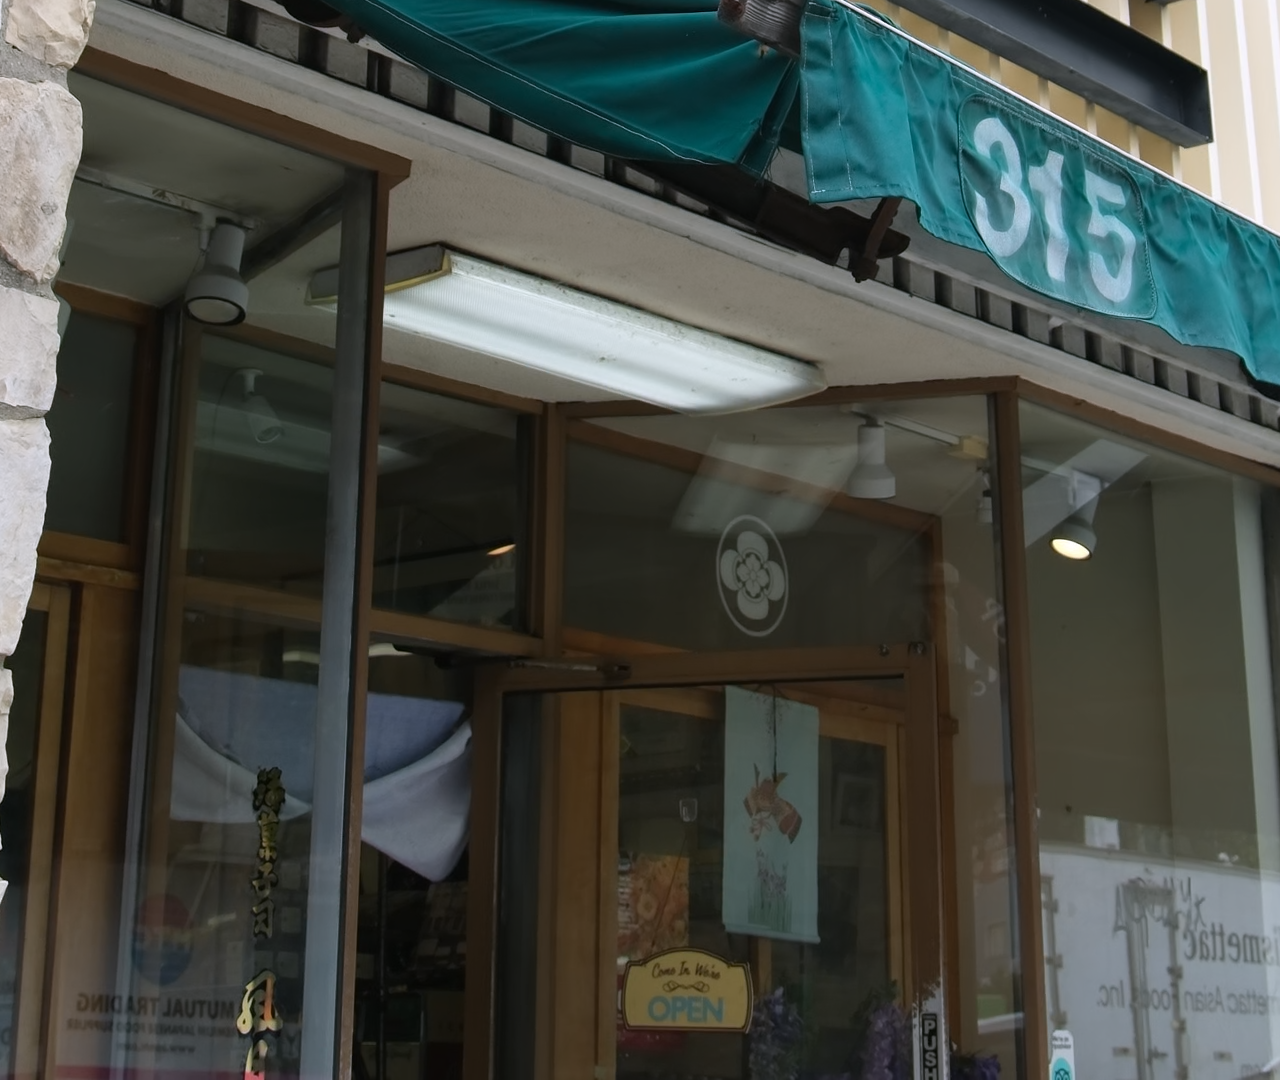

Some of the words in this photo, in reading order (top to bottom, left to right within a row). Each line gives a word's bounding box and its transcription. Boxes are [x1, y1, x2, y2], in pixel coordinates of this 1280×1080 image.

[973, 115, 1136, 304] 315
[677, 960, 691, 977] In
[647, 994, 725, 1024] OPEN
[923, 1019, 938, 1080] PUSH
